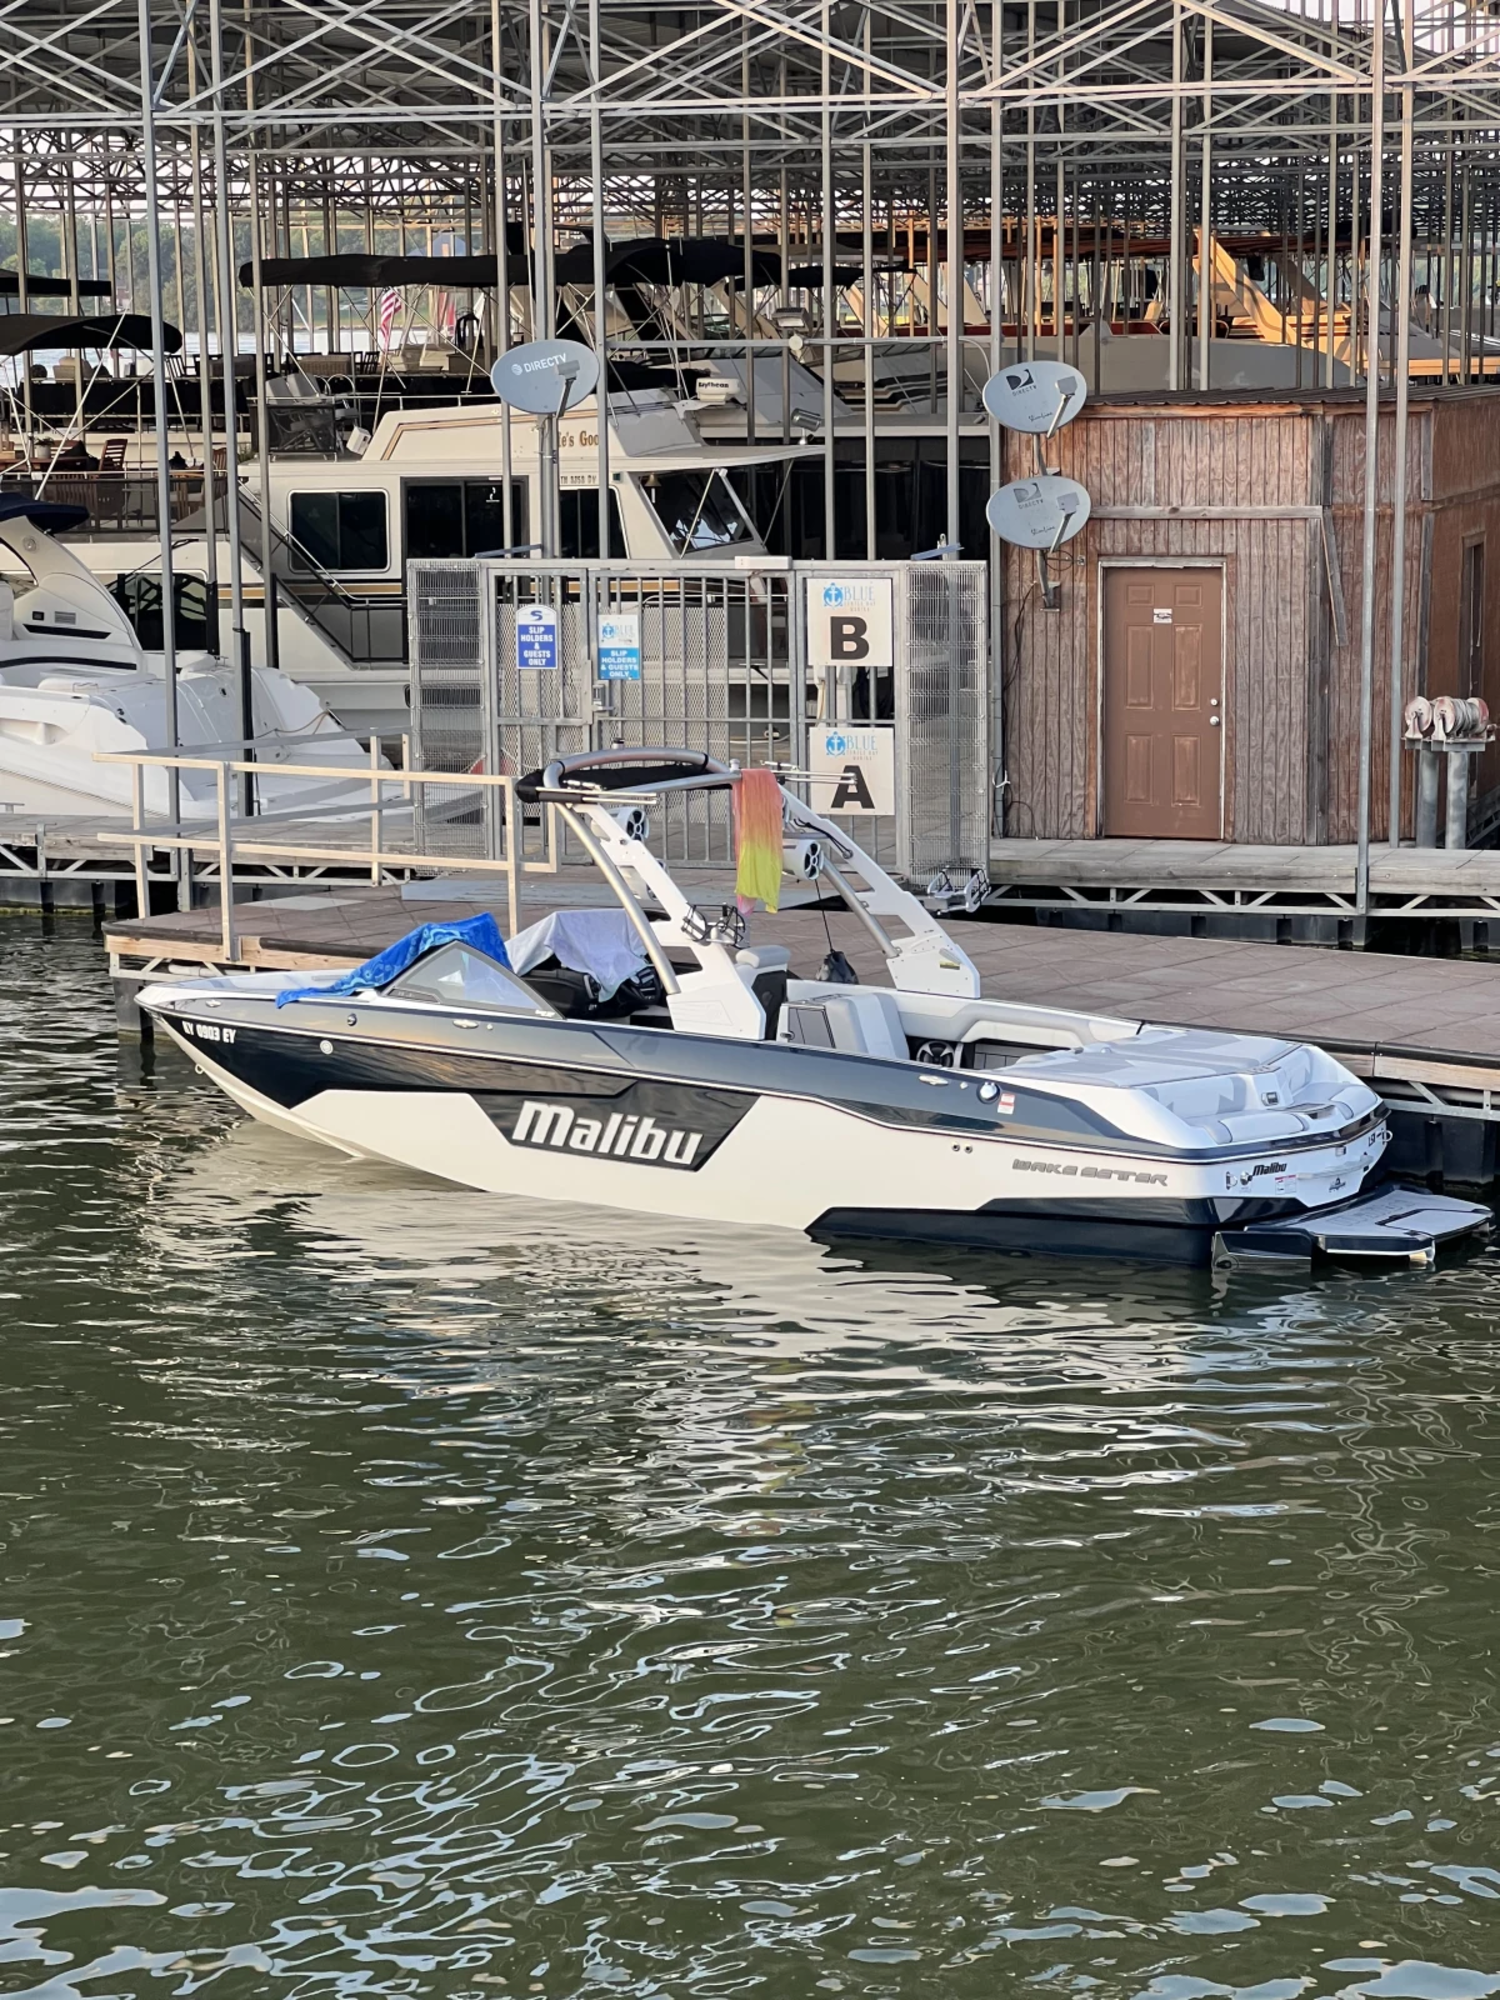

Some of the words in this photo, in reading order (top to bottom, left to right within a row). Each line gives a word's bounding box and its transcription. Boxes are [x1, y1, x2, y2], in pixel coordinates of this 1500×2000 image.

[524, 353, 567, 373] DIRECTV
[1012, 385, 1037, 396] DIRECTV
[580, 430, 599, 446] Goo
[1018, 499, 1043, 509] DIRECTV
[844, 586, 875, 601] BLUE
[528, 626, 545, 634] SLIP
[520, 634, 553, 642] HOLDERS
[830, 616, 870, 660] B
[534, 642, 540, 650] &
[523, 650, 551, 658] GUESTS
[528, 658, 547, 666] ONLY
[847, 735, 878, 750] BLUE
[831, 765, 875, 809] A
[223, 1028, 236, 1044] EY
[512, 1100, 703, 1165] Malibu
[1253, 1162, 1287, 1176] Malibu
